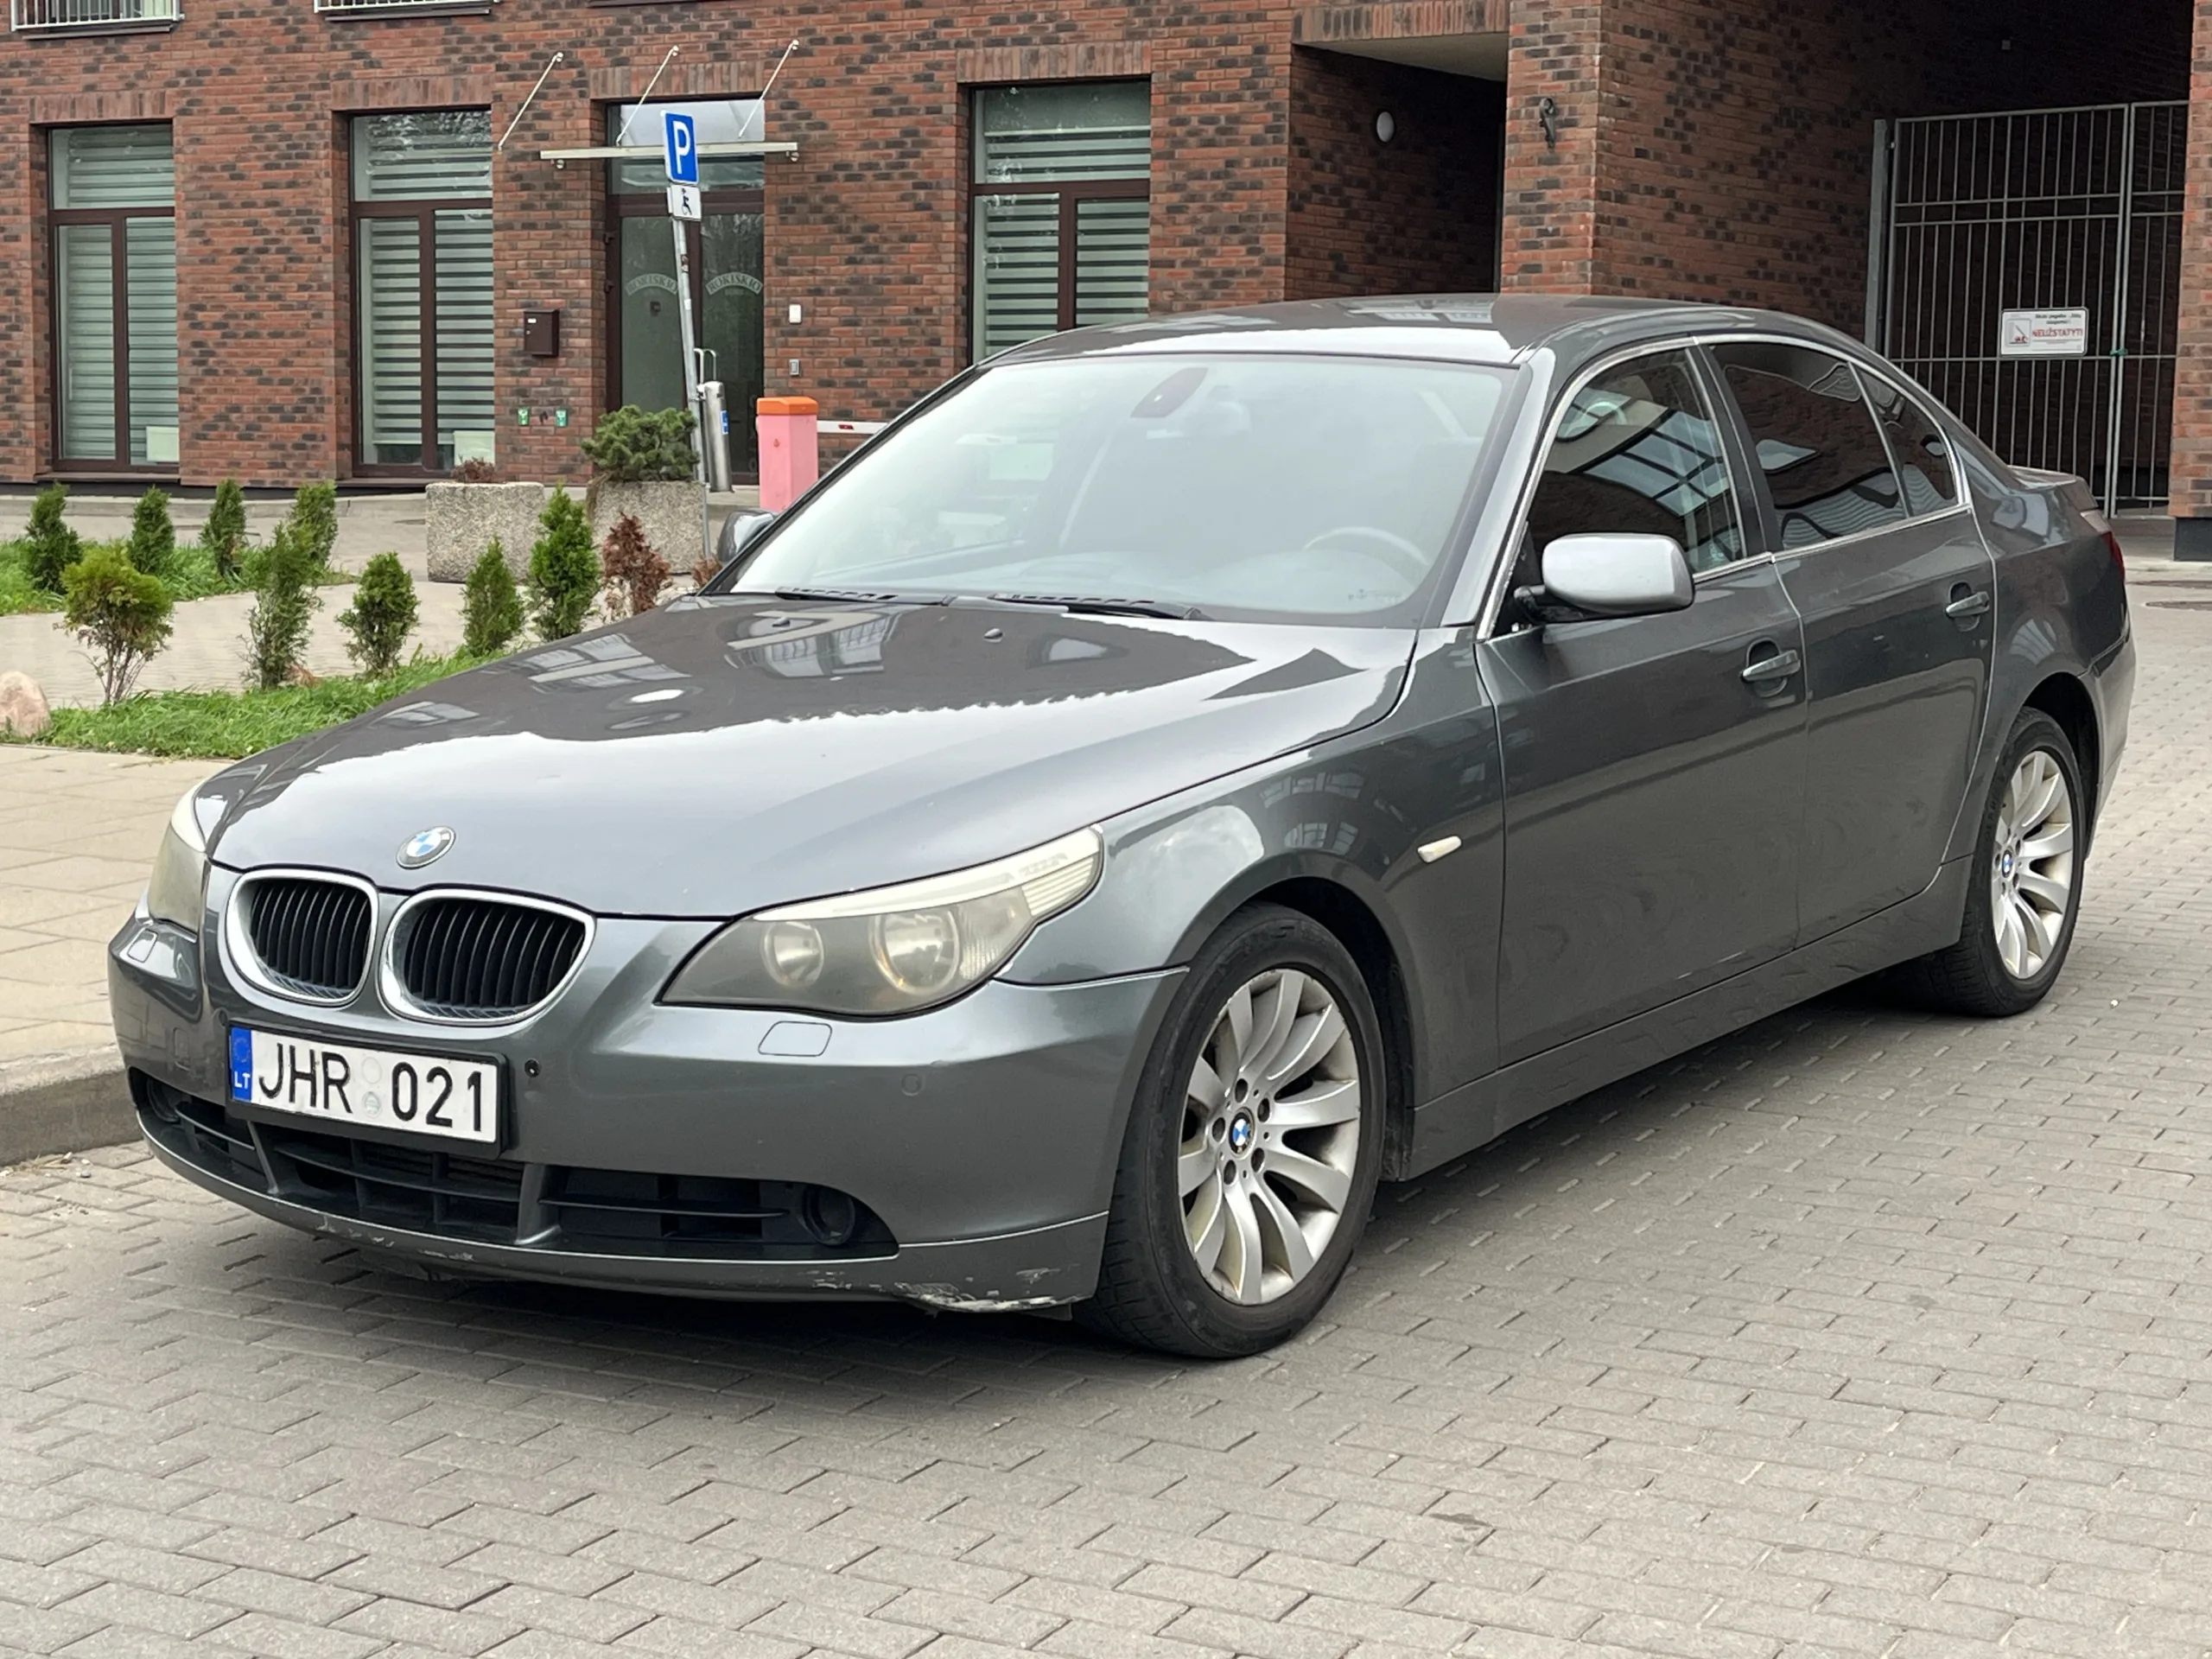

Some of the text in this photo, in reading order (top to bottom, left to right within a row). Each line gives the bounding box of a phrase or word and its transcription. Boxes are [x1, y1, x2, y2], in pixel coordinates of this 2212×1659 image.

[672, 120, 690, 175] P
[233, 1071, 251, 1090] LT
[258, 1043, 481, 1132] JHR 021
